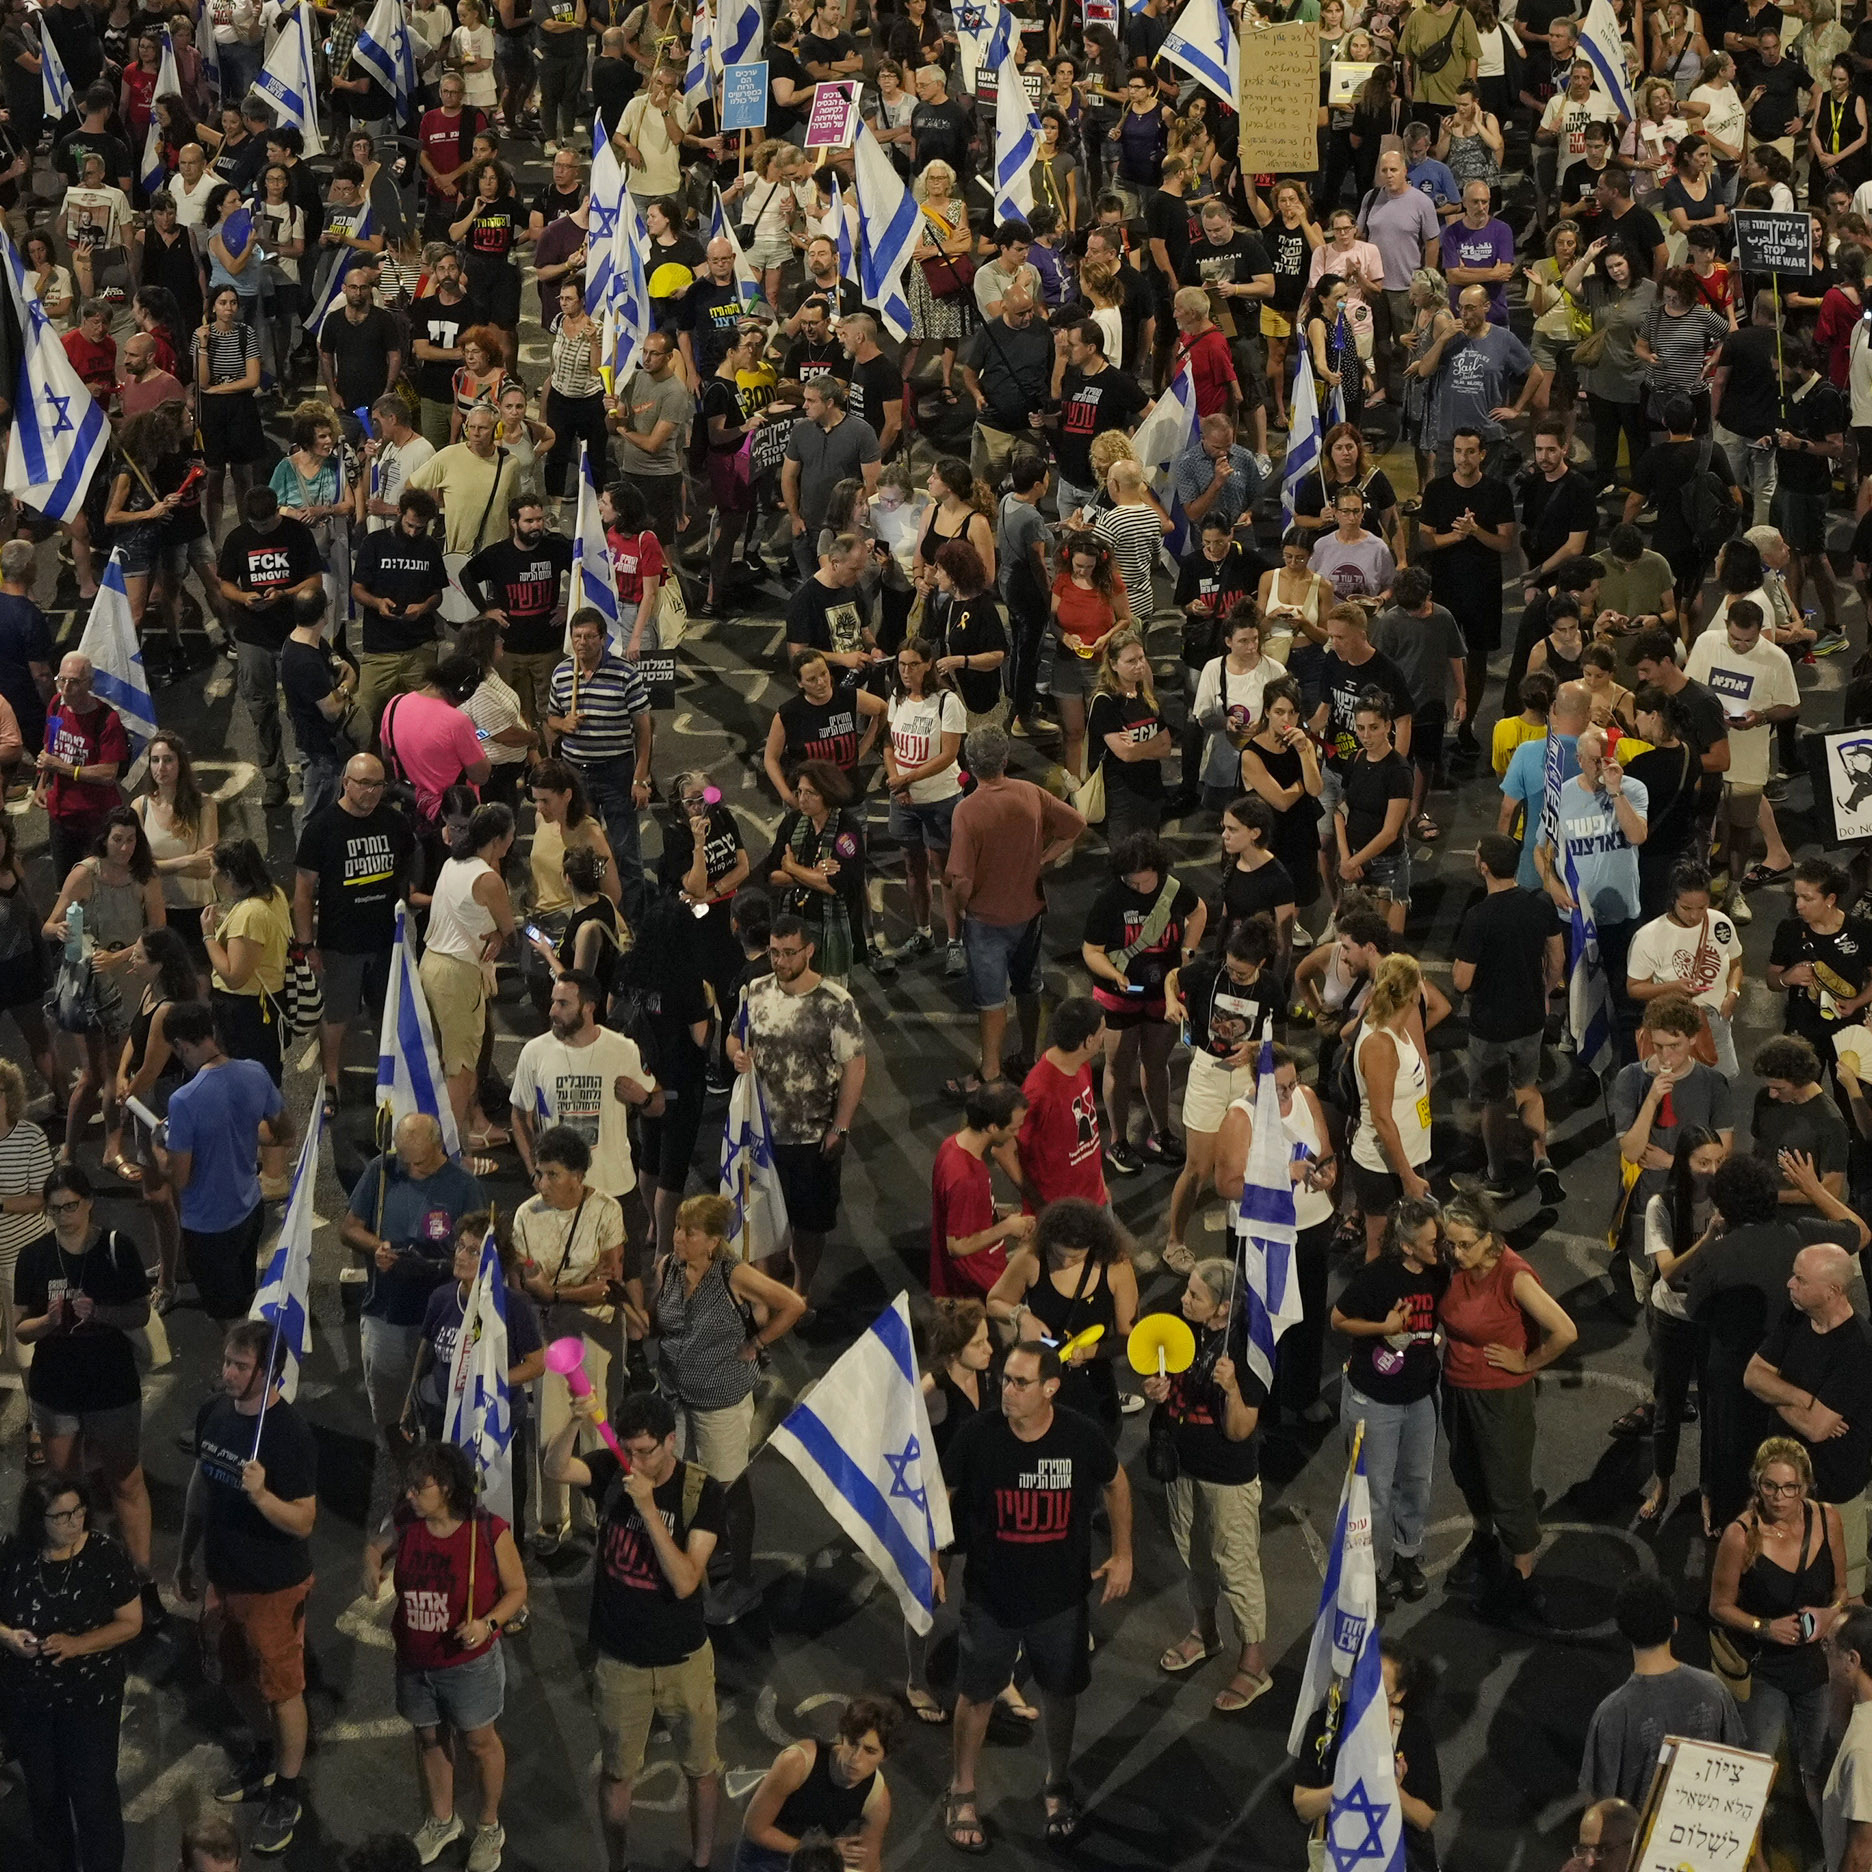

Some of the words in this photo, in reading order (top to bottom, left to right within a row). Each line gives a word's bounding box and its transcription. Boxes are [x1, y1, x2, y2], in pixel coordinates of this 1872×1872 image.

[735, 68, 758, 78] ערכים
[1763, 244, 1786, 256] STOP
[1195, 252, 1243, 265] AMERICAN
[1763, 255, 1781, 266] THE
[1782, 256, 1806, 268] WAR
[248, 552, 290, 572] FCK
[250, 569, 291, 584] BNGVR
[1838, 827, 1856, 838] DO
[346, 834, 392, 857] בוחרים
[1037, 1458, 1072, 1475] מחזירים
[1018, 1473, 1048, 1489] הביתה
[1049, 1473, 1072, 1489] אותם
[994, 1488, 1073, 1531] עכשיו
[404, 1590, 448, 1613] אתה
[406, 1609, 450, 1634] אשם
